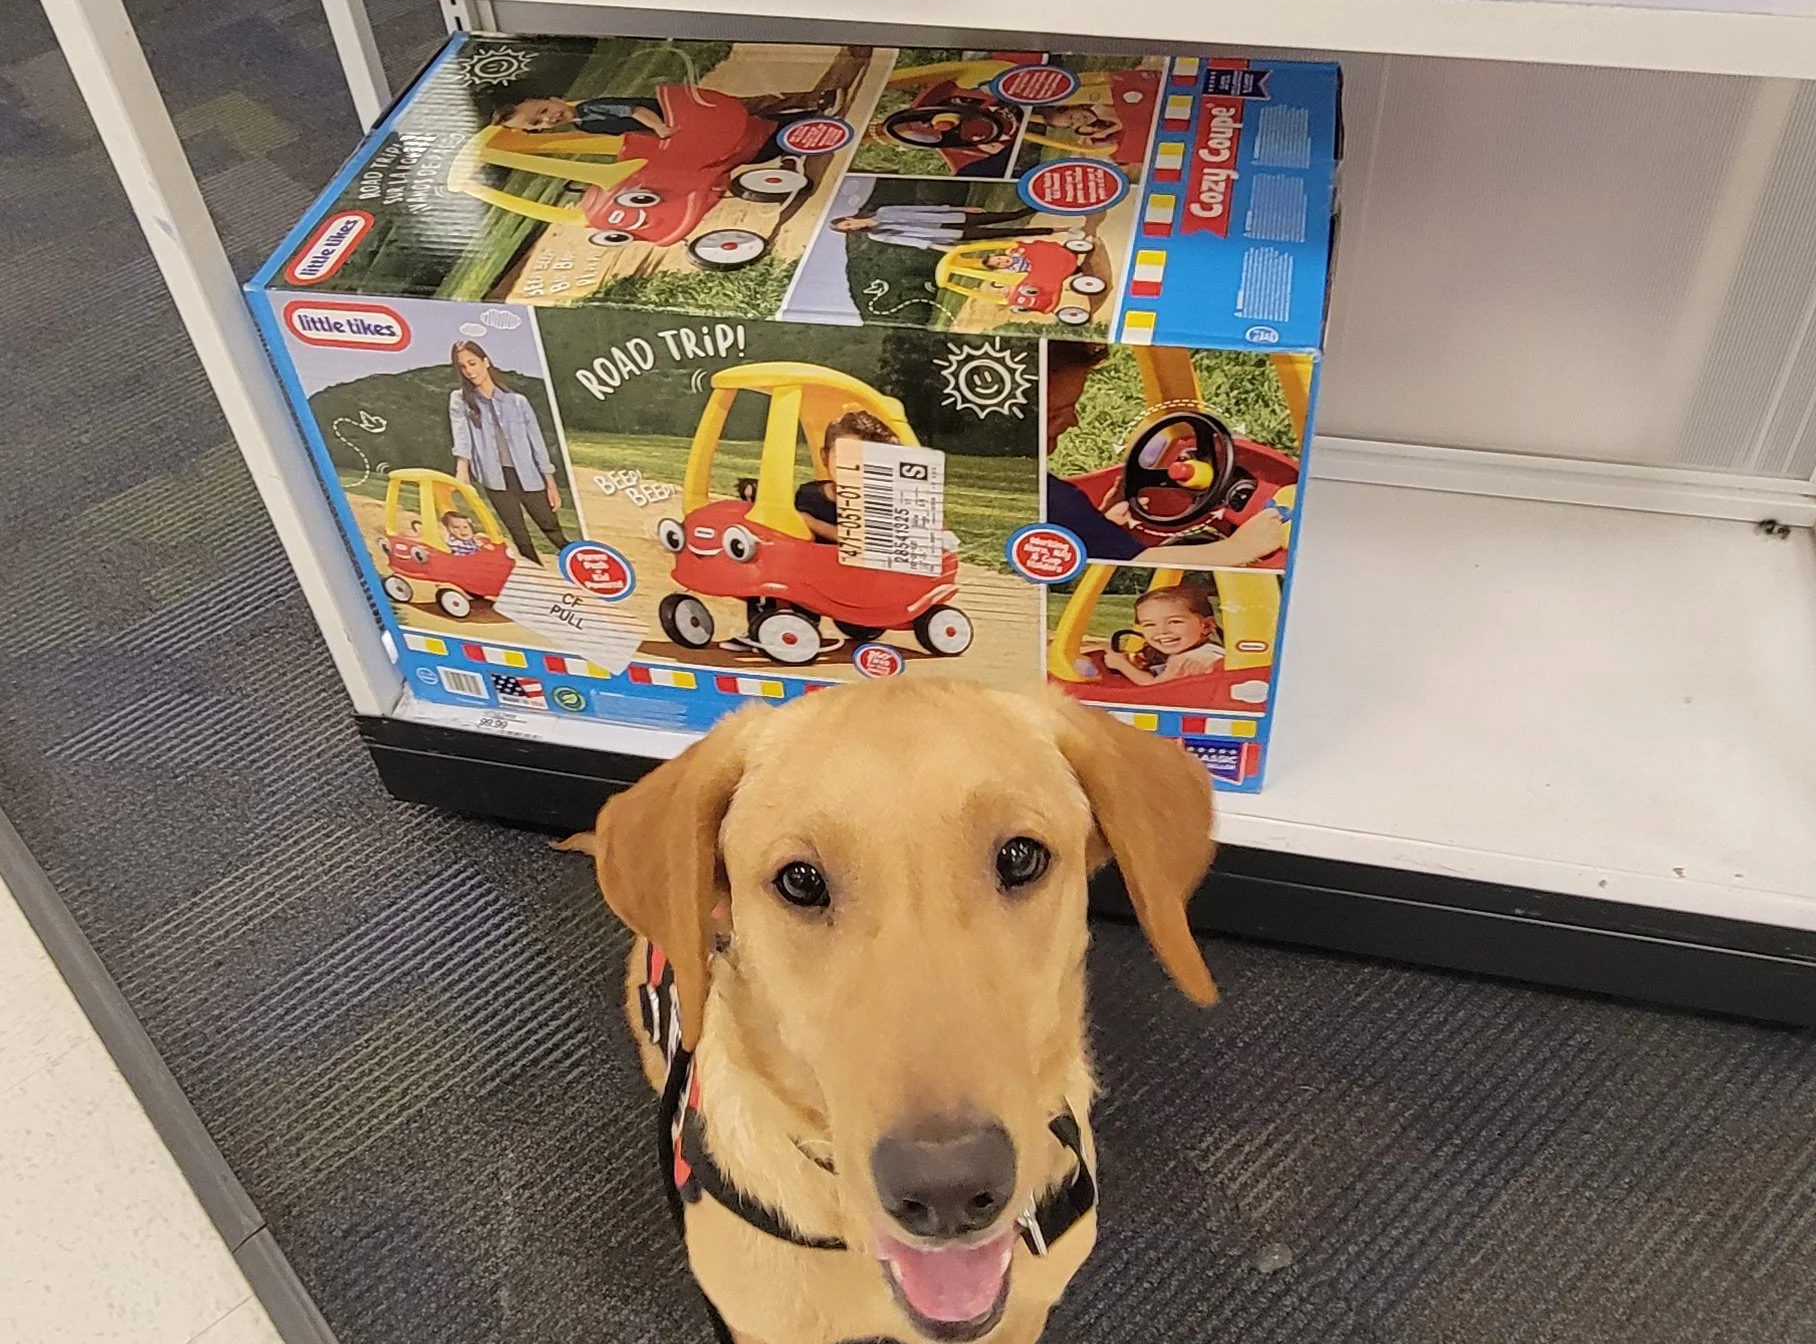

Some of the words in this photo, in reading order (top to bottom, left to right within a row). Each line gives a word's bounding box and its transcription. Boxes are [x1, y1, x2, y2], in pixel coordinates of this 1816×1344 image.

[358, 171, 384, 200] ROAD
[1189, 167, 1239, 219] Cozy
[299, 247, 336, 277] little
[324, 219, 359, 251] tikes
[297, 313, 347, 334] little
[346, 317, 397, 338] tikes
[575, 337, 655, 401] ROAD
[901, 465, 926, 479] S
[893, 508, 910, 564] 28541325
[562, 593, 584, 609] CF
[550, 604, 585, 631] PULL
